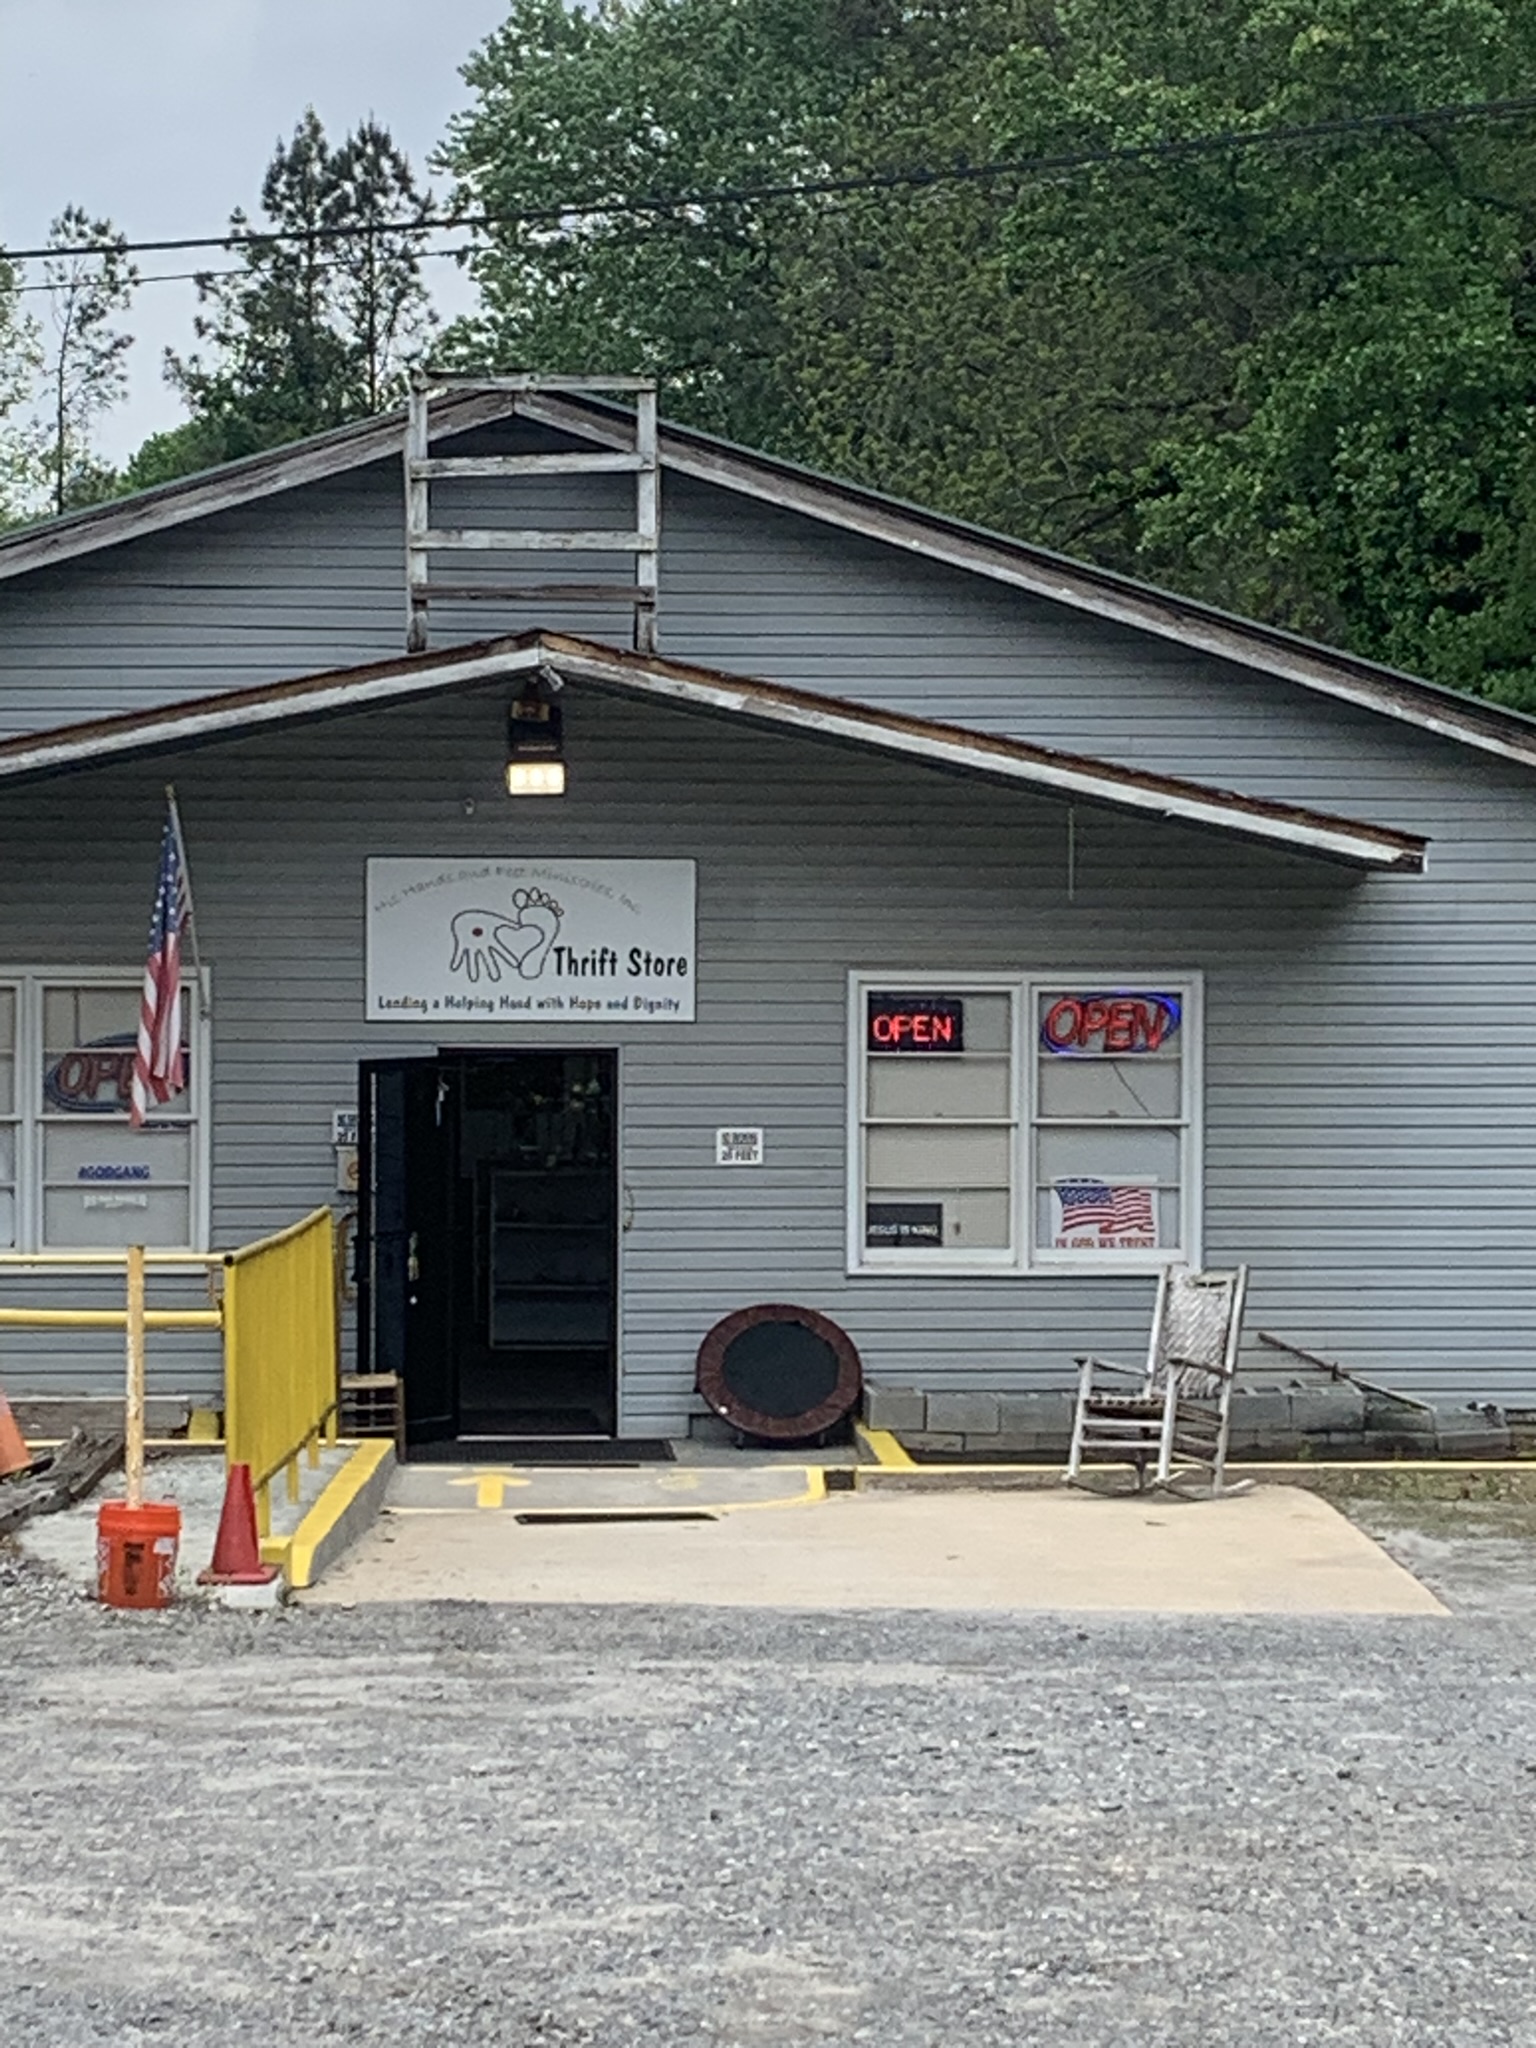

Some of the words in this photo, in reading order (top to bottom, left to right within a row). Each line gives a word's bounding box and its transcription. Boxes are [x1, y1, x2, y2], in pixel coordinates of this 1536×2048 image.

[553, 946, 619, 978] Thrift
[627, 946, 689, 978] Store
[444, 994, 495, 1014] Helping
[499, 994, 532, 1010] Hand
[536, 995, 564, 1009] with
[569, 995, 601, 1014] Hope
[606, 995, 628, 1010] and
[633, 994, 681, 1014] Dignity
[872, 1014, 953, 1043] OPEN
[1047, 998, 1166, 1053] OPEN
[59, 1053, 135, 1099] OPE
